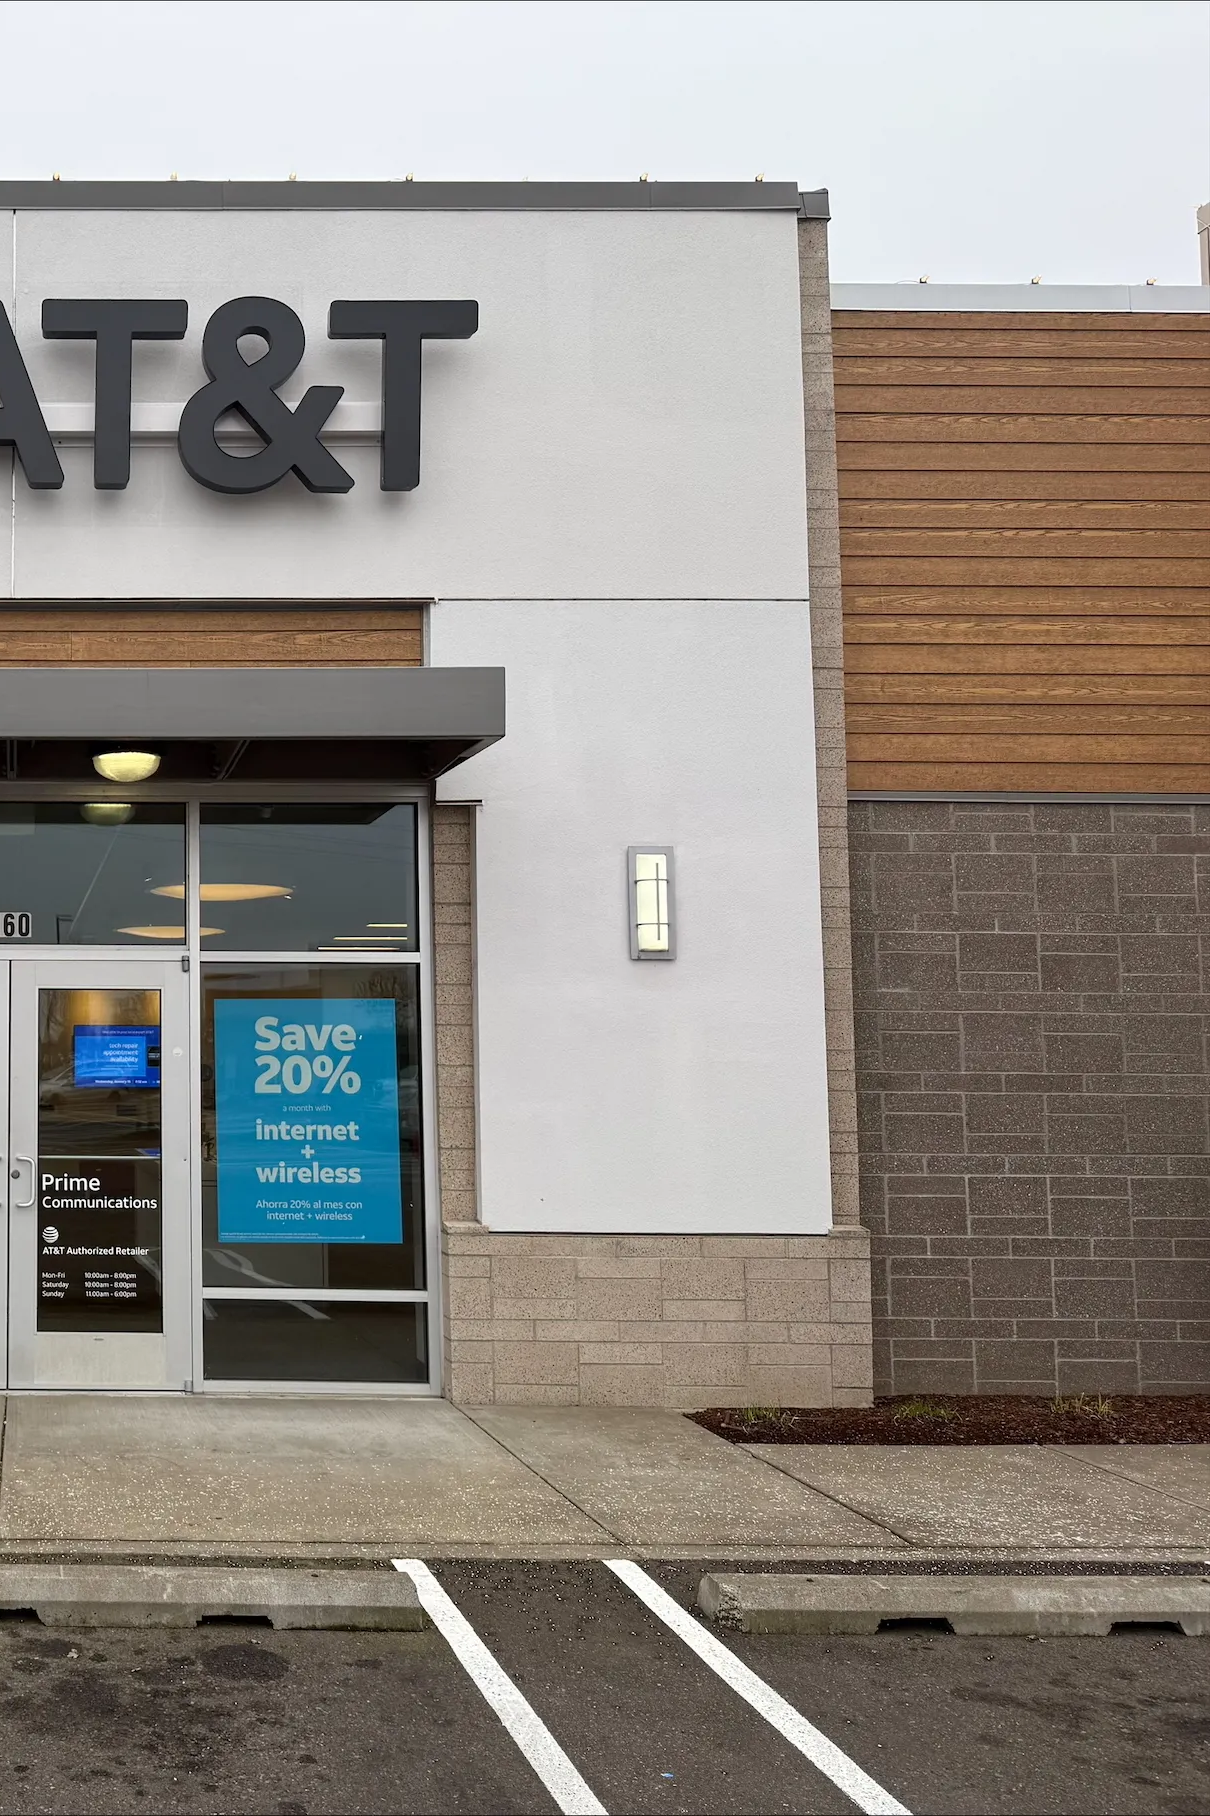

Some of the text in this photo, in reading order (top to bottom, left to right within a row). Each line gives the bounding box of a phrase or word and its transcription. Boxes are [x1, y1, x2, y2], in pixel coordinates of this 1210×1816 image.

[254, 1016, 356, 1051] Save
[254, 1055, 361, 1095] 20%
[315, 1104, 331, 1112] with
[256, 1118, 360, 1141] internet
[301, 1145, 315, 1158] +
[256, 1161, 361, 1183] wireless
[42, 1173, 101, 1191] Prime
[42, 1196, 158, 1209] Communications
[256, 1200, 288, 1209] Ahorra
[290, 1200, 311, 1209] 20%
[313, 1200, 322, 1209] al
[267, 1211, 304, 1220] internet
[315, 1211, 353, 1221] wireless
[42, 1247, 149, 1255] AT&T Authorized Retailer
[42, 1281, 69, 1289] Saturday
